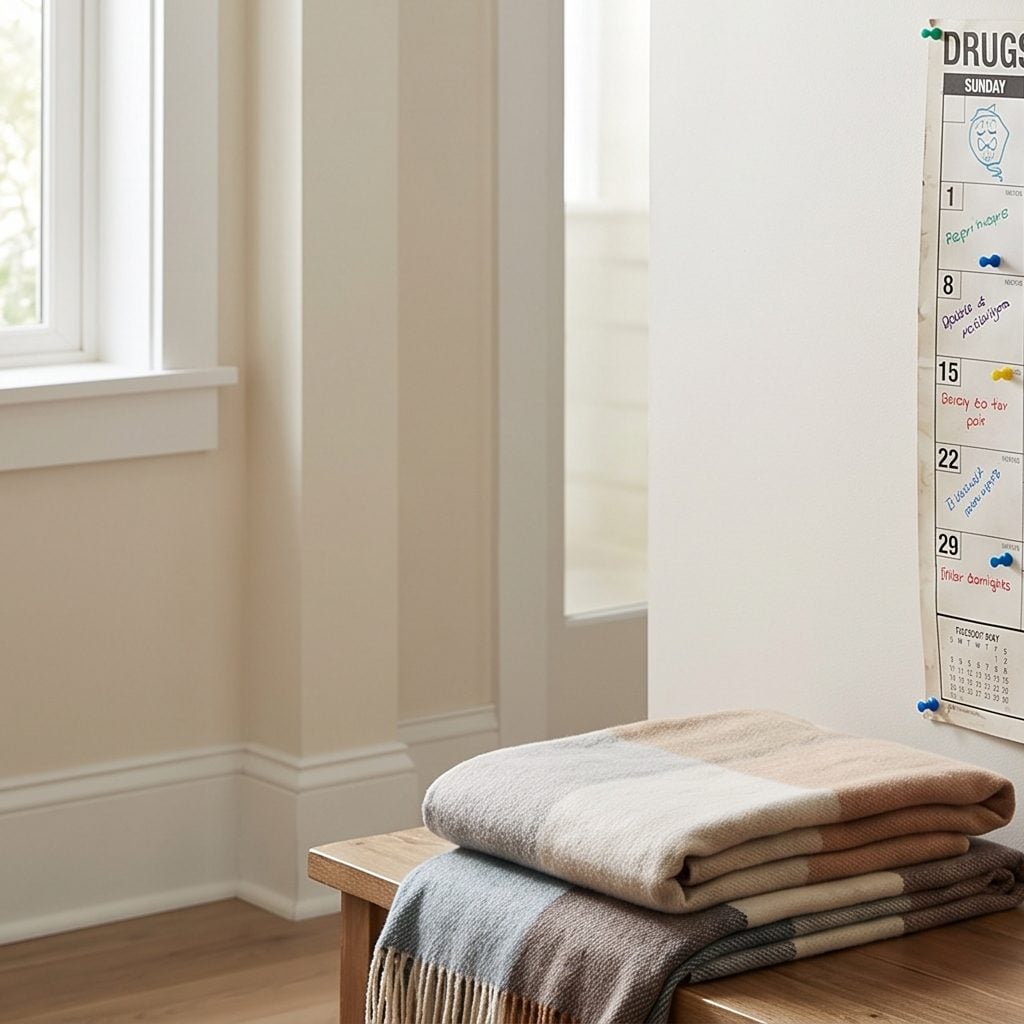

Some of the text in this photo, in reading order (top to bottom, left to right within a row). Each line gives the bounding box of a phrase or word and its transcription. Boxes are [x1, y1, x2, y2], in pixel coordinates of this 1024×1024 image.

[964, 79, 1006, 94] SUNDAY
[947, 186, 953, 206] 1
[943, 275, 953, 295] 8
[939, 361, 958, 383] 15
[939, 448, 958, 469] 22
[939, 533, 958, 555] 29
